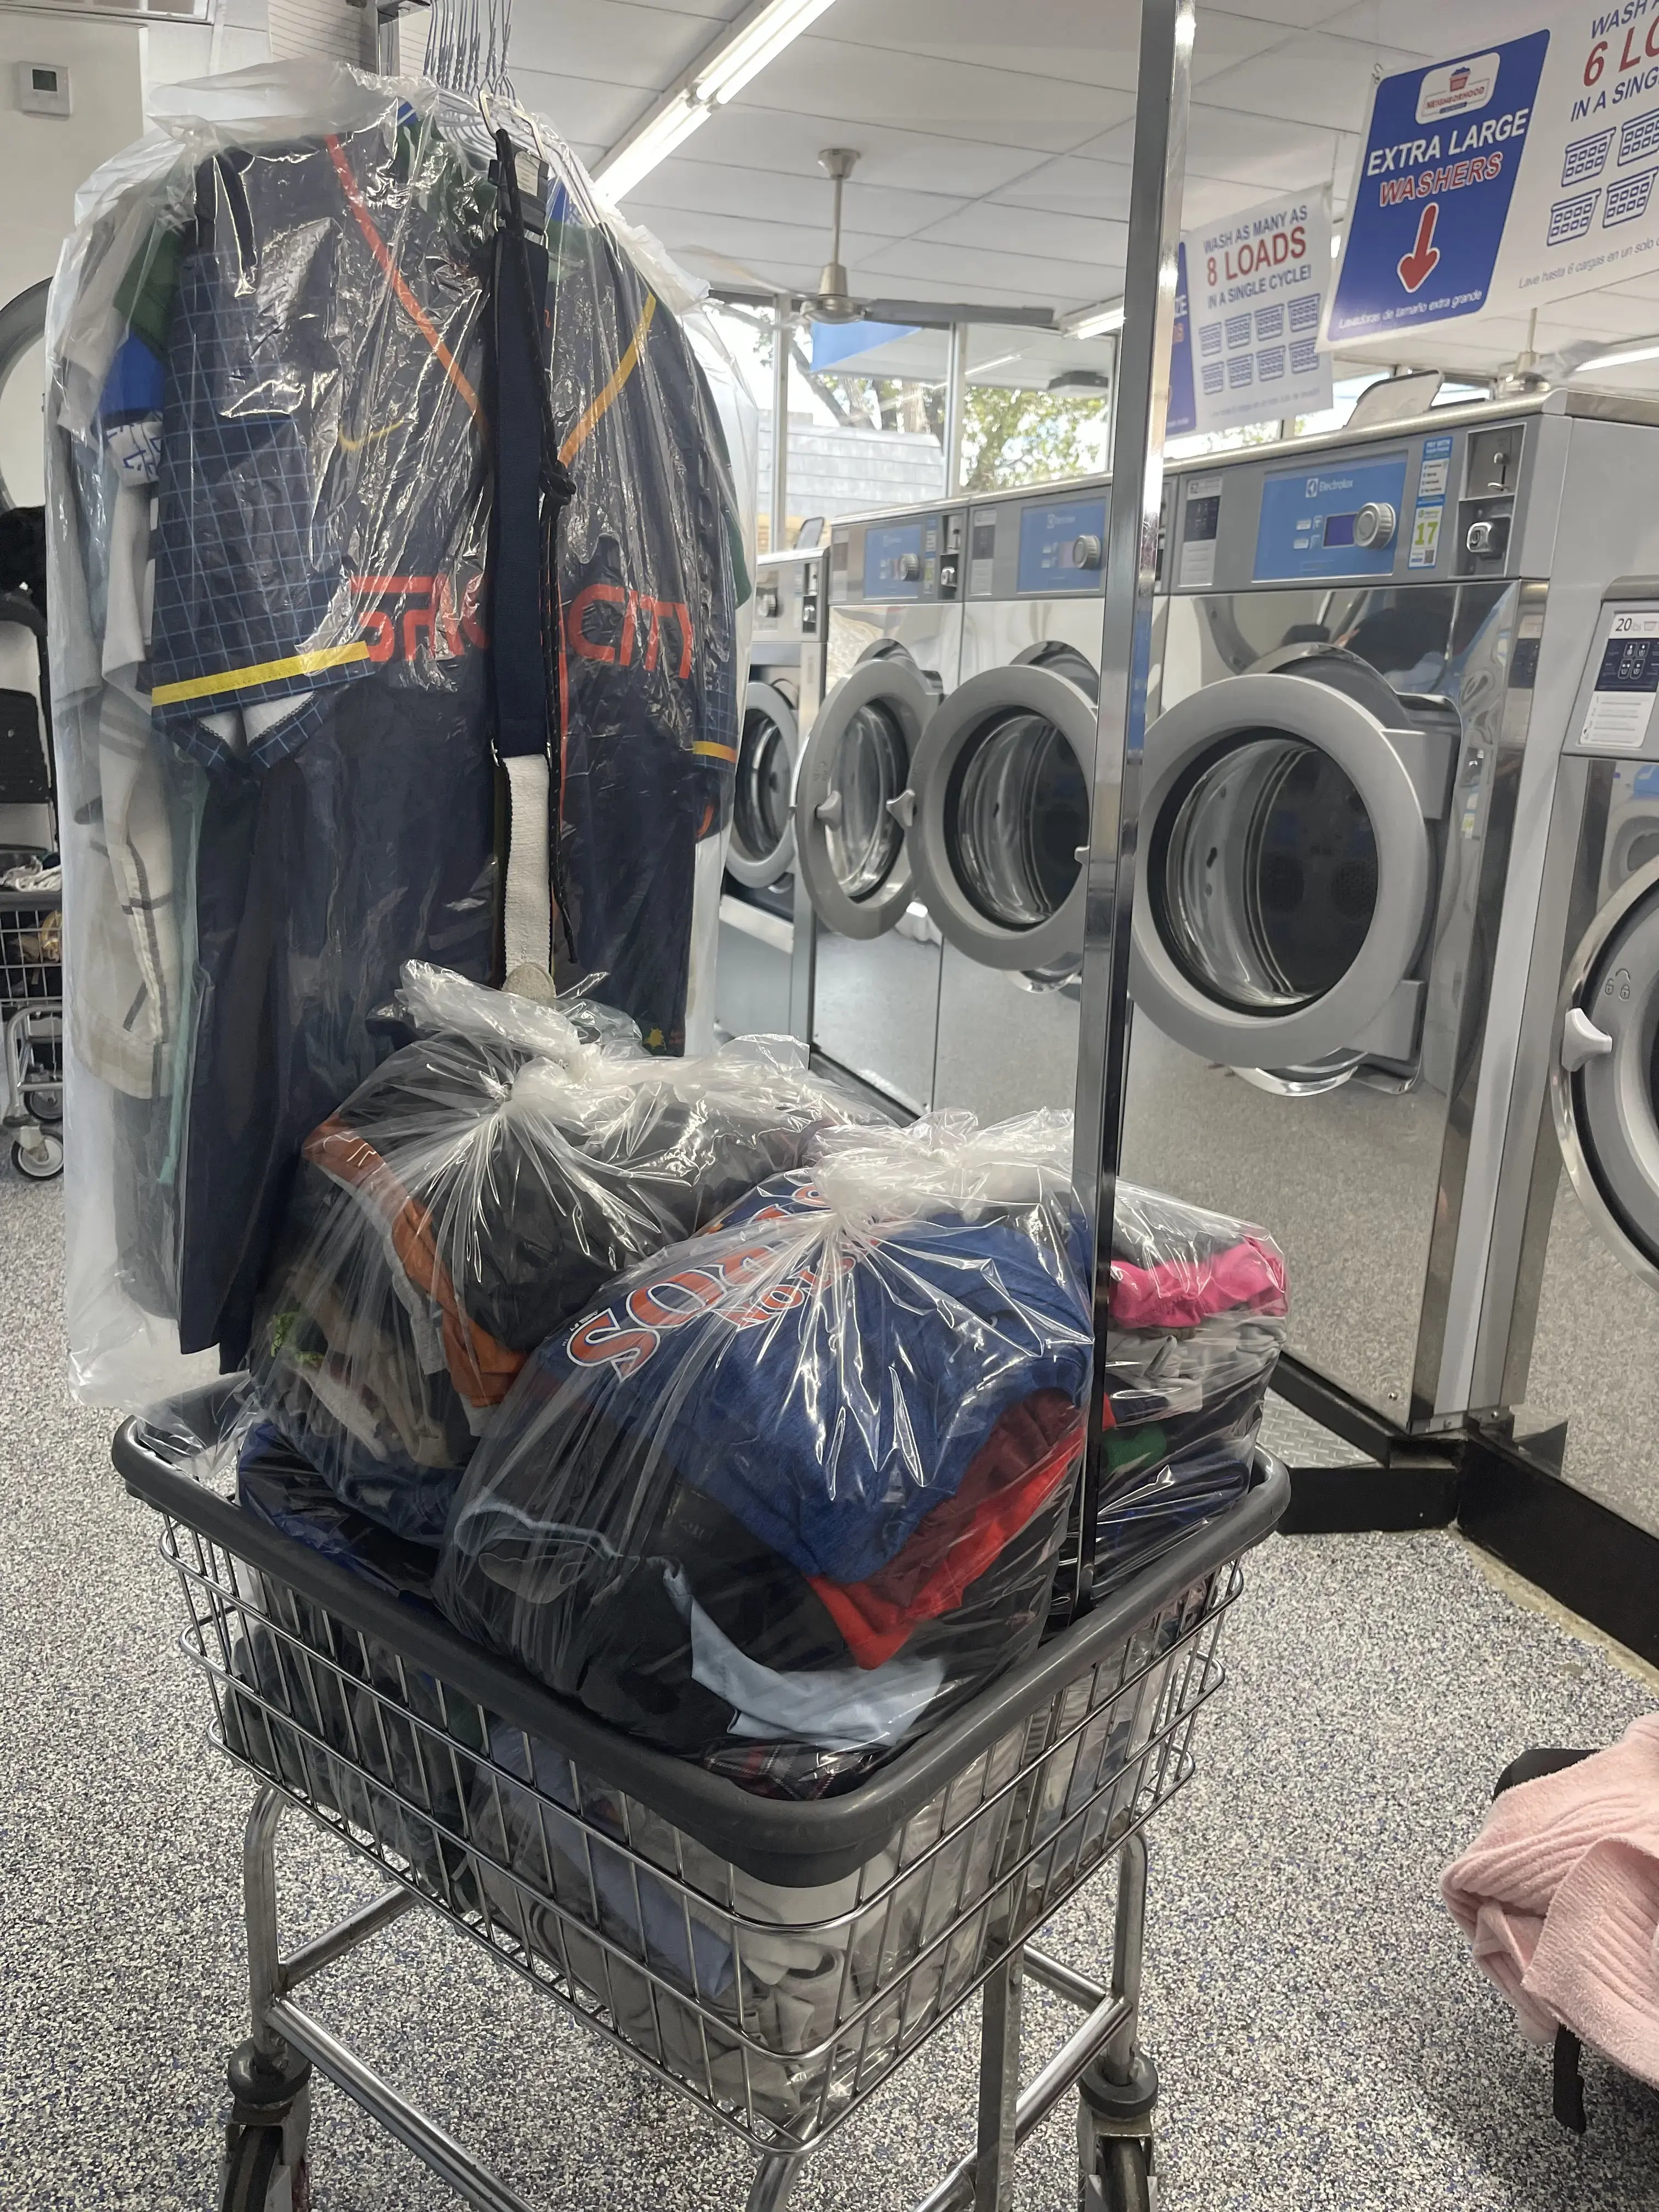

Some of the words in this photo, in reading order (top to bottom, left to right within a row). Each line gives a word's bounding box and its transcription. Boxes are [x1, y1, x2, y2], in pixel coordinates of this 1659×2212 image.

[1583, 41, 1608, 87] 6
[1571, 97, 1590, 122] IN
[1593, 91, 1606, 113] A
[1367, 135, 1441, 177] EXTRA
[1448, 108, 1530, 156] LARGE
[1379, 151, 1504, 207] WASHERS
[1204, 232, 1233, 254] WASH
[1235, 224, 1250, 245] AS
[1253, 211, 1288, 238] MANY
[1290, 205, 1308, 225] AS
[1207, 257, 1217, 286] 8
[1225, 225, 1307, 281] LOADS
[1567, 262, 1574, 274] 6
[1208, 293, 1217, 309] IN
[1219, 288, 1227, 305] A
[1228, 278, 1266, 303] SINGLE
[1268, 263, 1312, 291] CYCLE!
[1414, 522, 1438, 546] 17
[1615, 618, 1632, 631] 20
